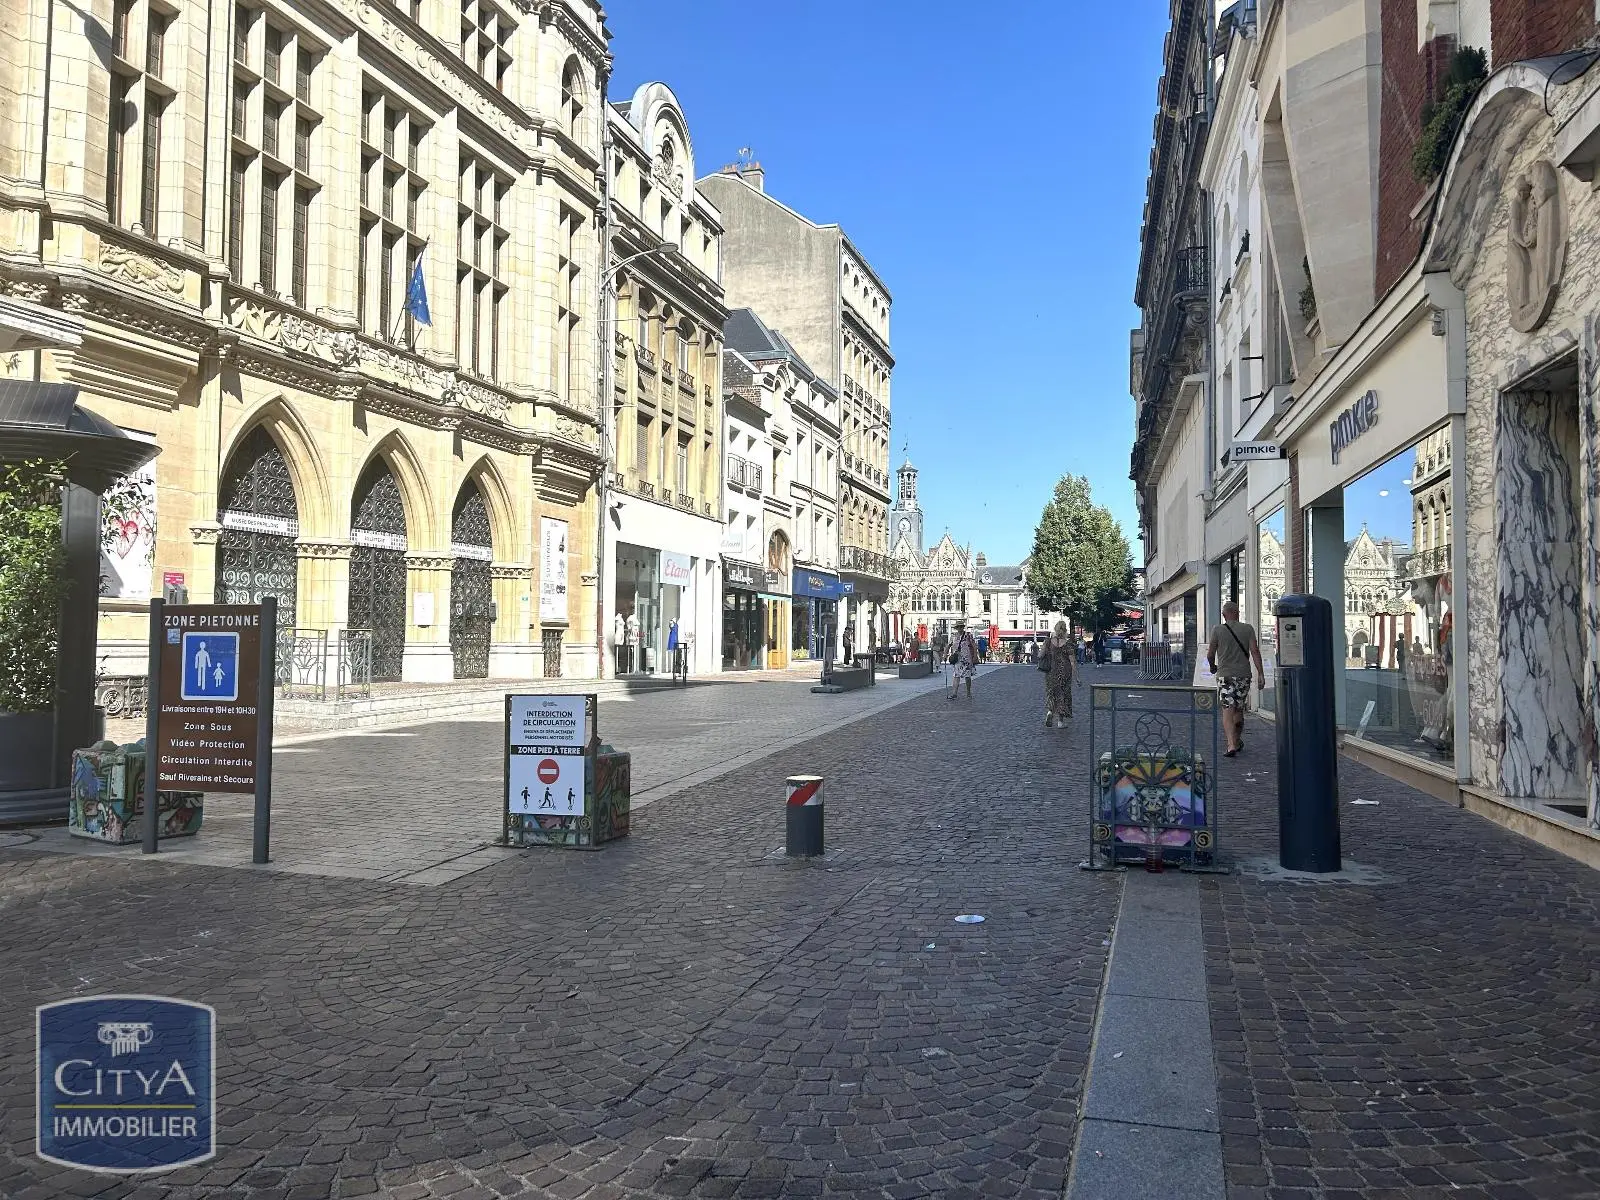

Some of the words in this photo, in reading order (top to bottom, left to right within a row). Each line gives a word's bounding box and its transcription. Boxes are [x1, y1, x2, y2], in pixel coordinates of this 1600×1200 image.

[1330, 390, 1379, 465] pimkie
[1235, 445, 1276, 457] pimkie
[664, 558, 690, 579] Etam
[164, 615, 196, 627] ZONE
[200, 615, 259, 626] PIETONNE
[162, 705, 196, 713] Livraisons
[196, 706, 214, 714] entre
[215, 706, 227, 714] 19H
[235, 706, 256, 715] 10H30
[526, 710, 573, 718] INTERDICTION
[184, 722, 205, 730] Zone
[210, 723, 232, 731] Sous
[199, 739, 245, 749] Protection
[518, 746, 537, 754] ZONE
[538, 746, 553, 754] PIED
[554, 745, 559, 754] À
[161, 756, 210, 765] Circulation
[214, 758, 253, 767] Interdite
[159, 772, 176, 781] Sauf
[178, 774, 212, 782] Riverains
[214, 775, 222, 783] et
[223, 775, 254, 784] Secours
